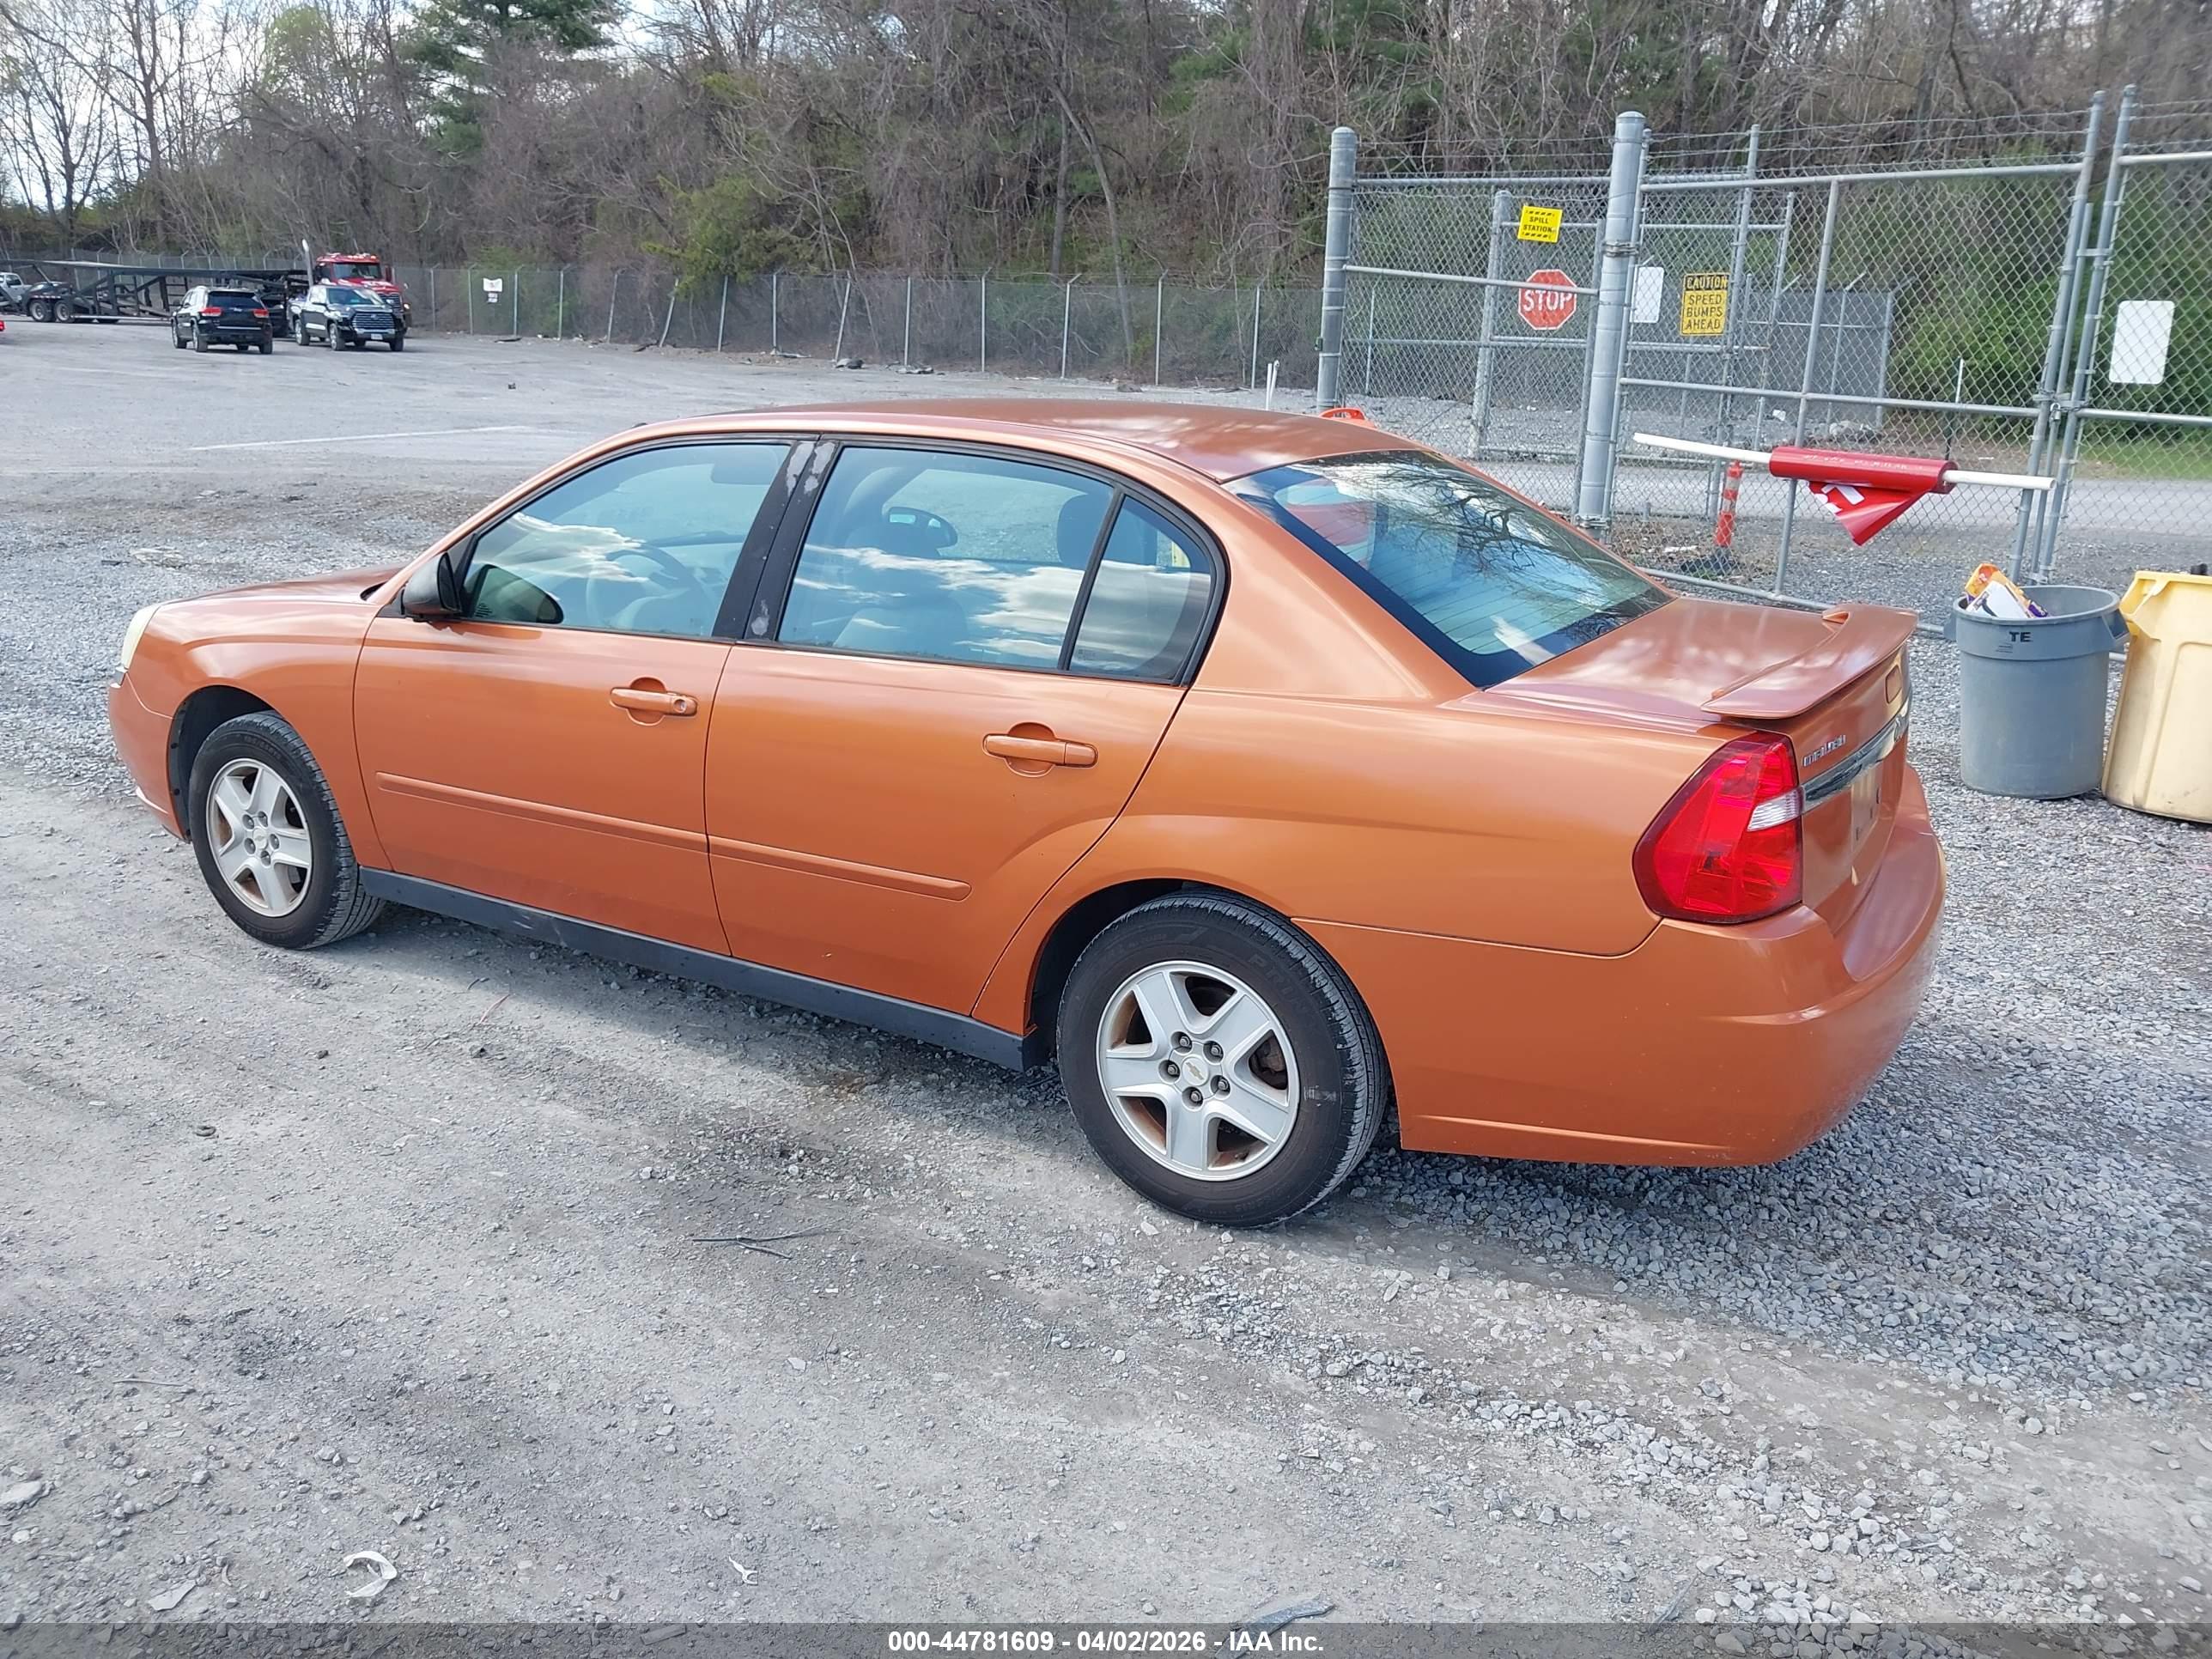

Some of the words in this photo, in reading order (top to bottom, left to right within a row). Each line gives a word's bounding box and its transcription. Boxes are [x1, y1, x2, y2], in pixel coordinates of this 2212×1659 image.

[1523, 224, 1553, 233] STATION
[1686, 276, 1728, 289] CAUTION
[1523, 289, 1572, 311] STOP
[1689, 295, 1723, 305] SPEED
[1686, 307, 1723, 317] BUMPS
[1684, 319, 1721, 330] AHEAD
[2009, 631, 2032, 642] TE
